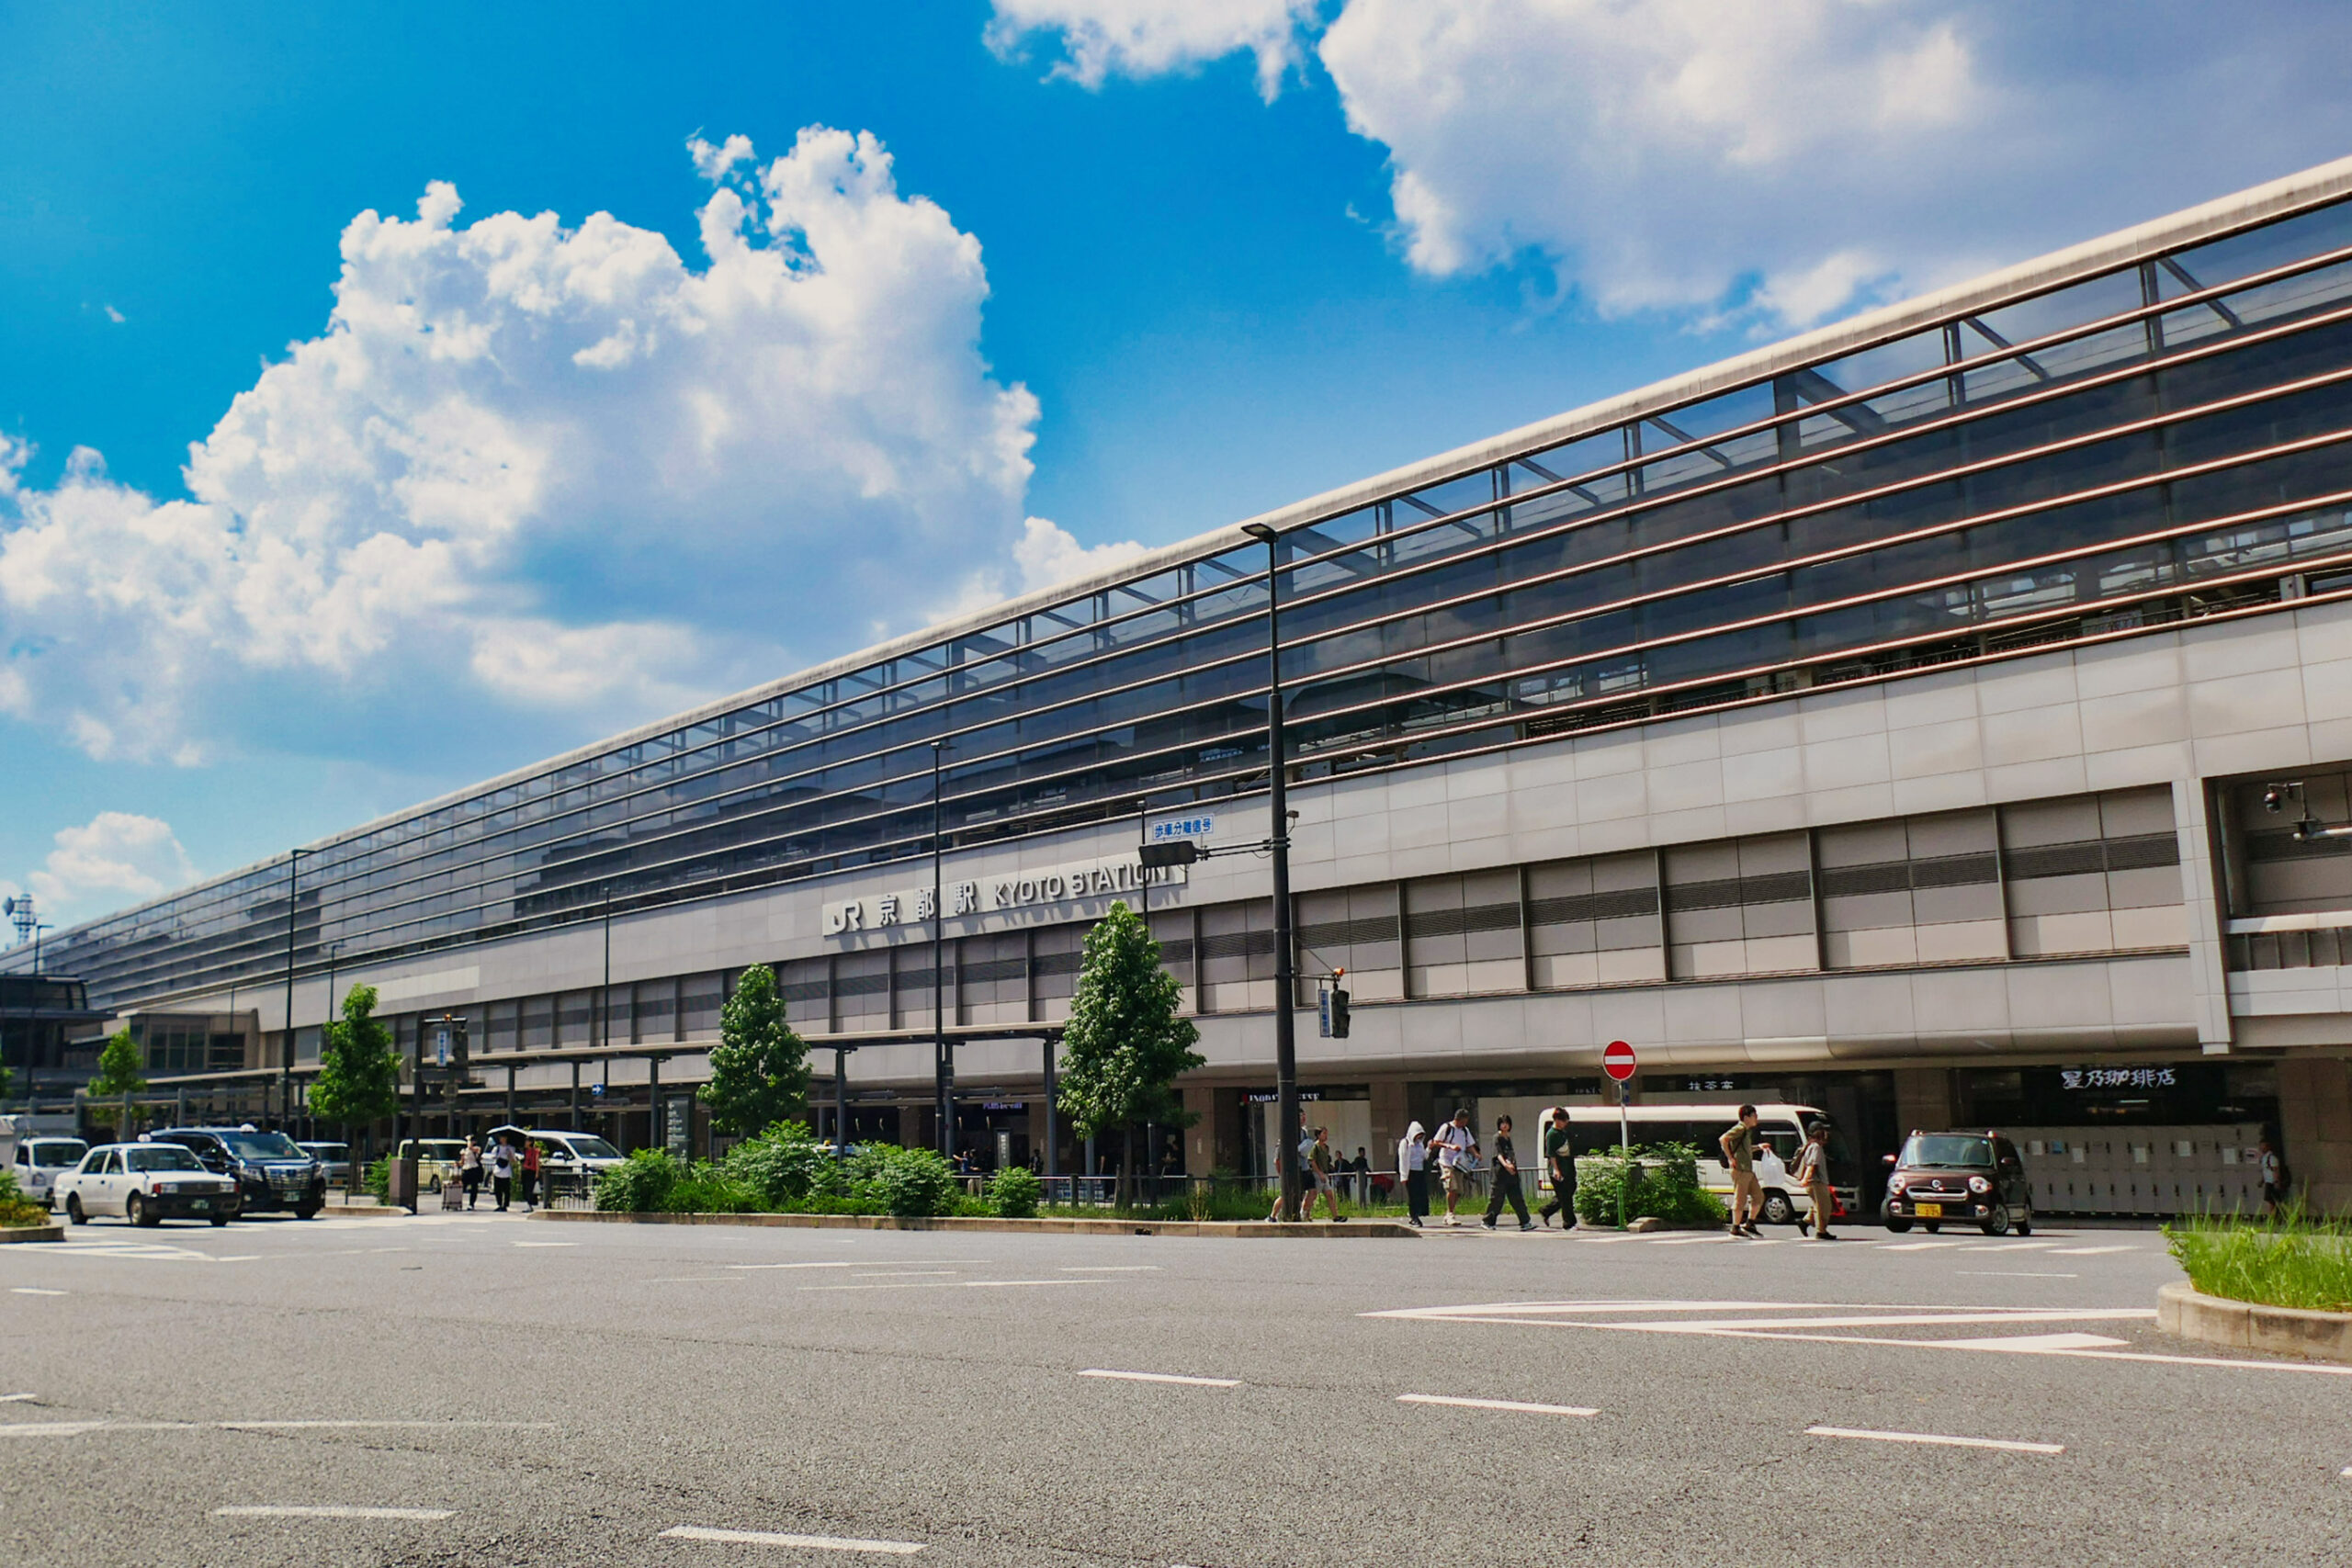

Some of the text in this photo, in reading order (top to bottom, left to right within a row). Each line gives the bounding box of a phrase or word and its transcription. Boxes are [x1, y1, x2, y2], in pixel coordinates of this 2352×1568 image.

[1155, 818, 1213, 838] 歩車分離信号
[831, 863, 1168, 932] JR 京都駅 KYOTO STATION
[2061, 1069, 2176, 1090] 星乃珈琲店
